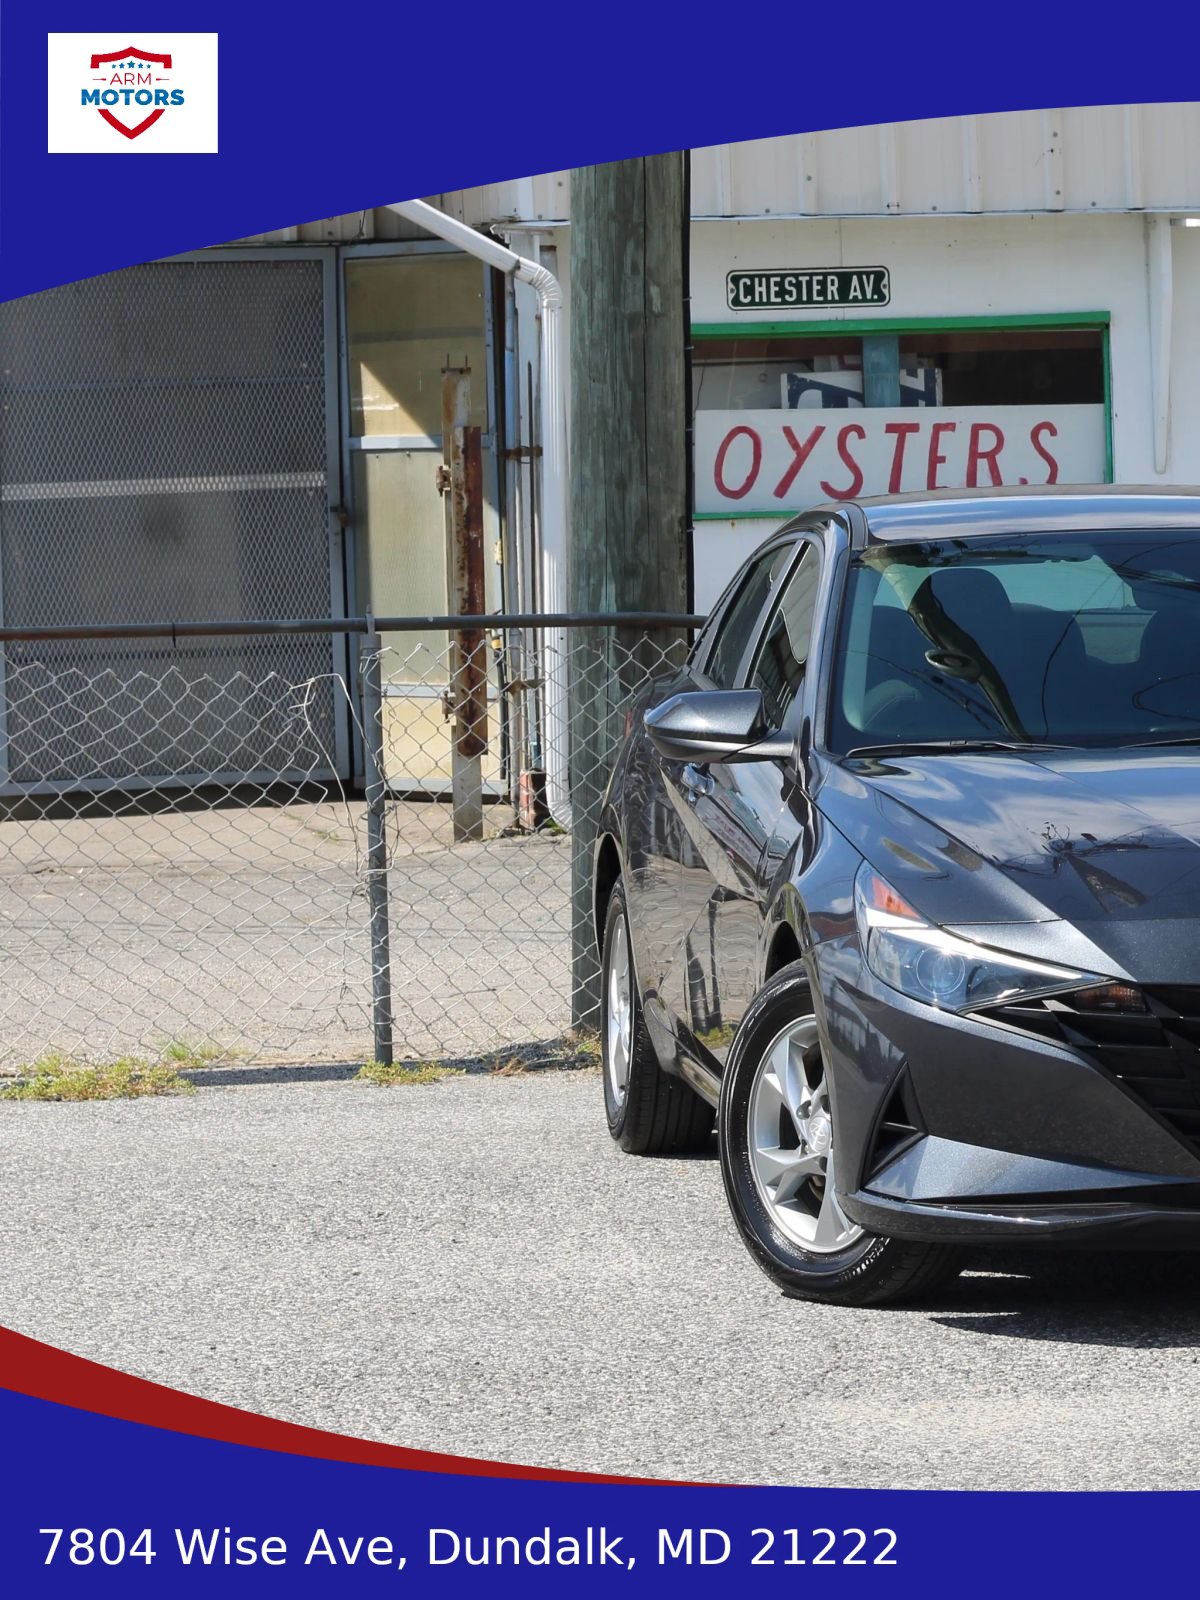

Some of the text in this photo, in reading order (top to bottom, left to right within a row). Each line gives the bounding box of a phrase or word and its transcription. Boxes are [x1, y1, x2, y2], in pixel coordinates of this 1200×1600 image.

[738, 273, 878, 303] CHESTER AV.
[713, 421, 1059, 500] OYSTERS
